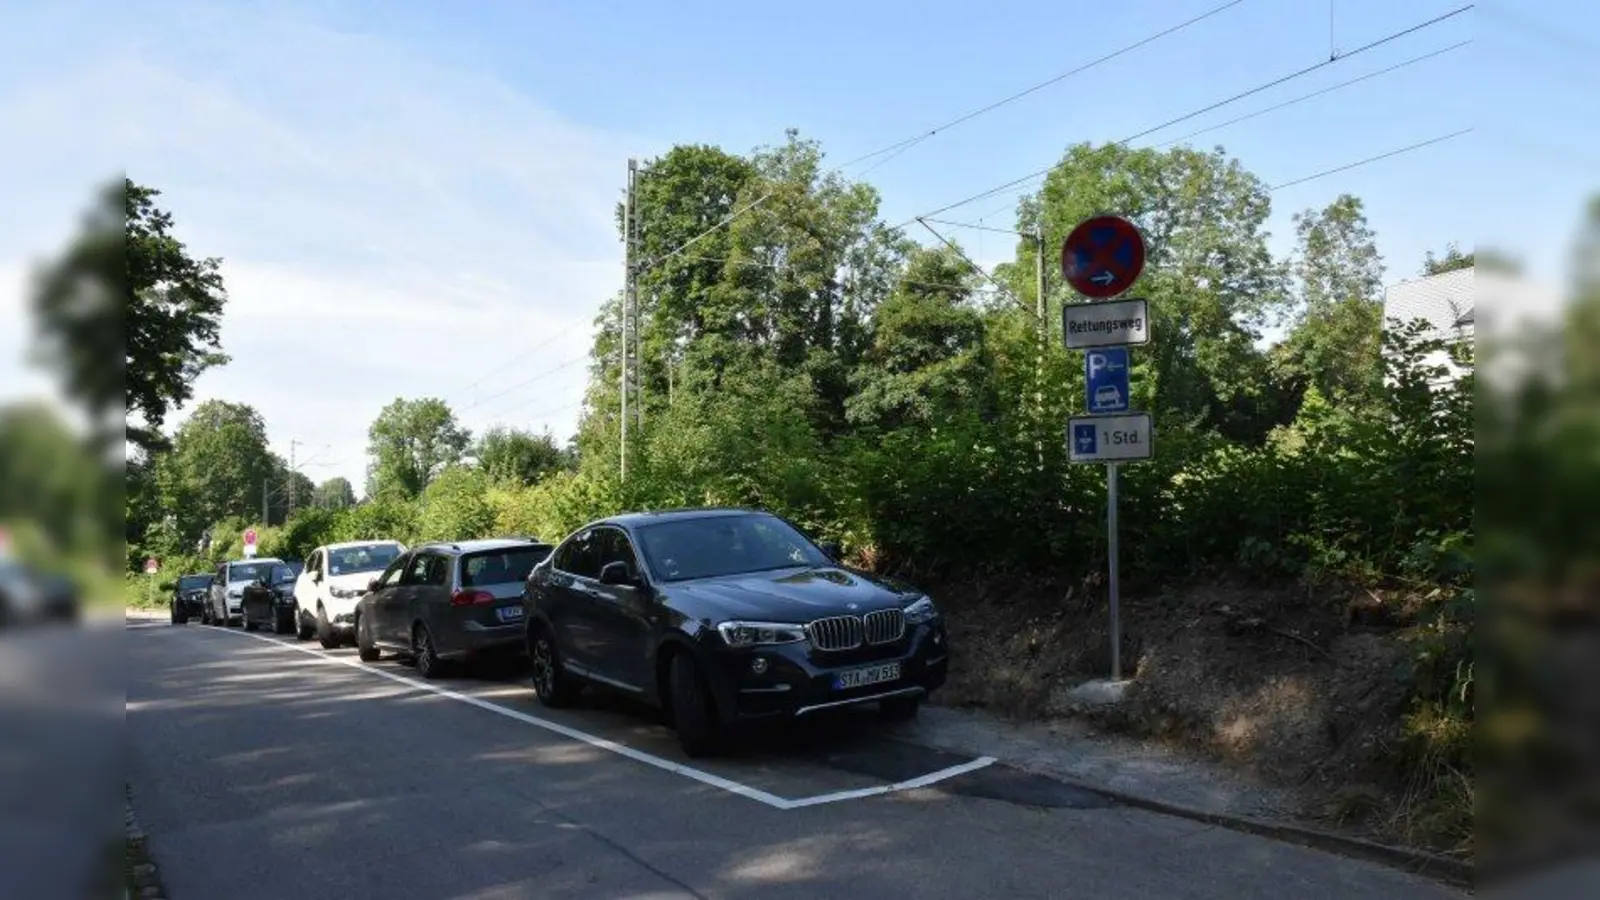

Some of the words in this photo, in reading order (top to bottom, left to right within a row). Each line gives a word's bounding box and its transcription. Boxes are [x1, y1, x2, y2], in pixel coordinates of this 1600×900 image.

[1069, 318, 1142, 334] Rettungsweg
[1089, 354, 1107, 379] P
[1102, 431, 1110, 446] 1
[1112, 429, 1143, 446] Std.
